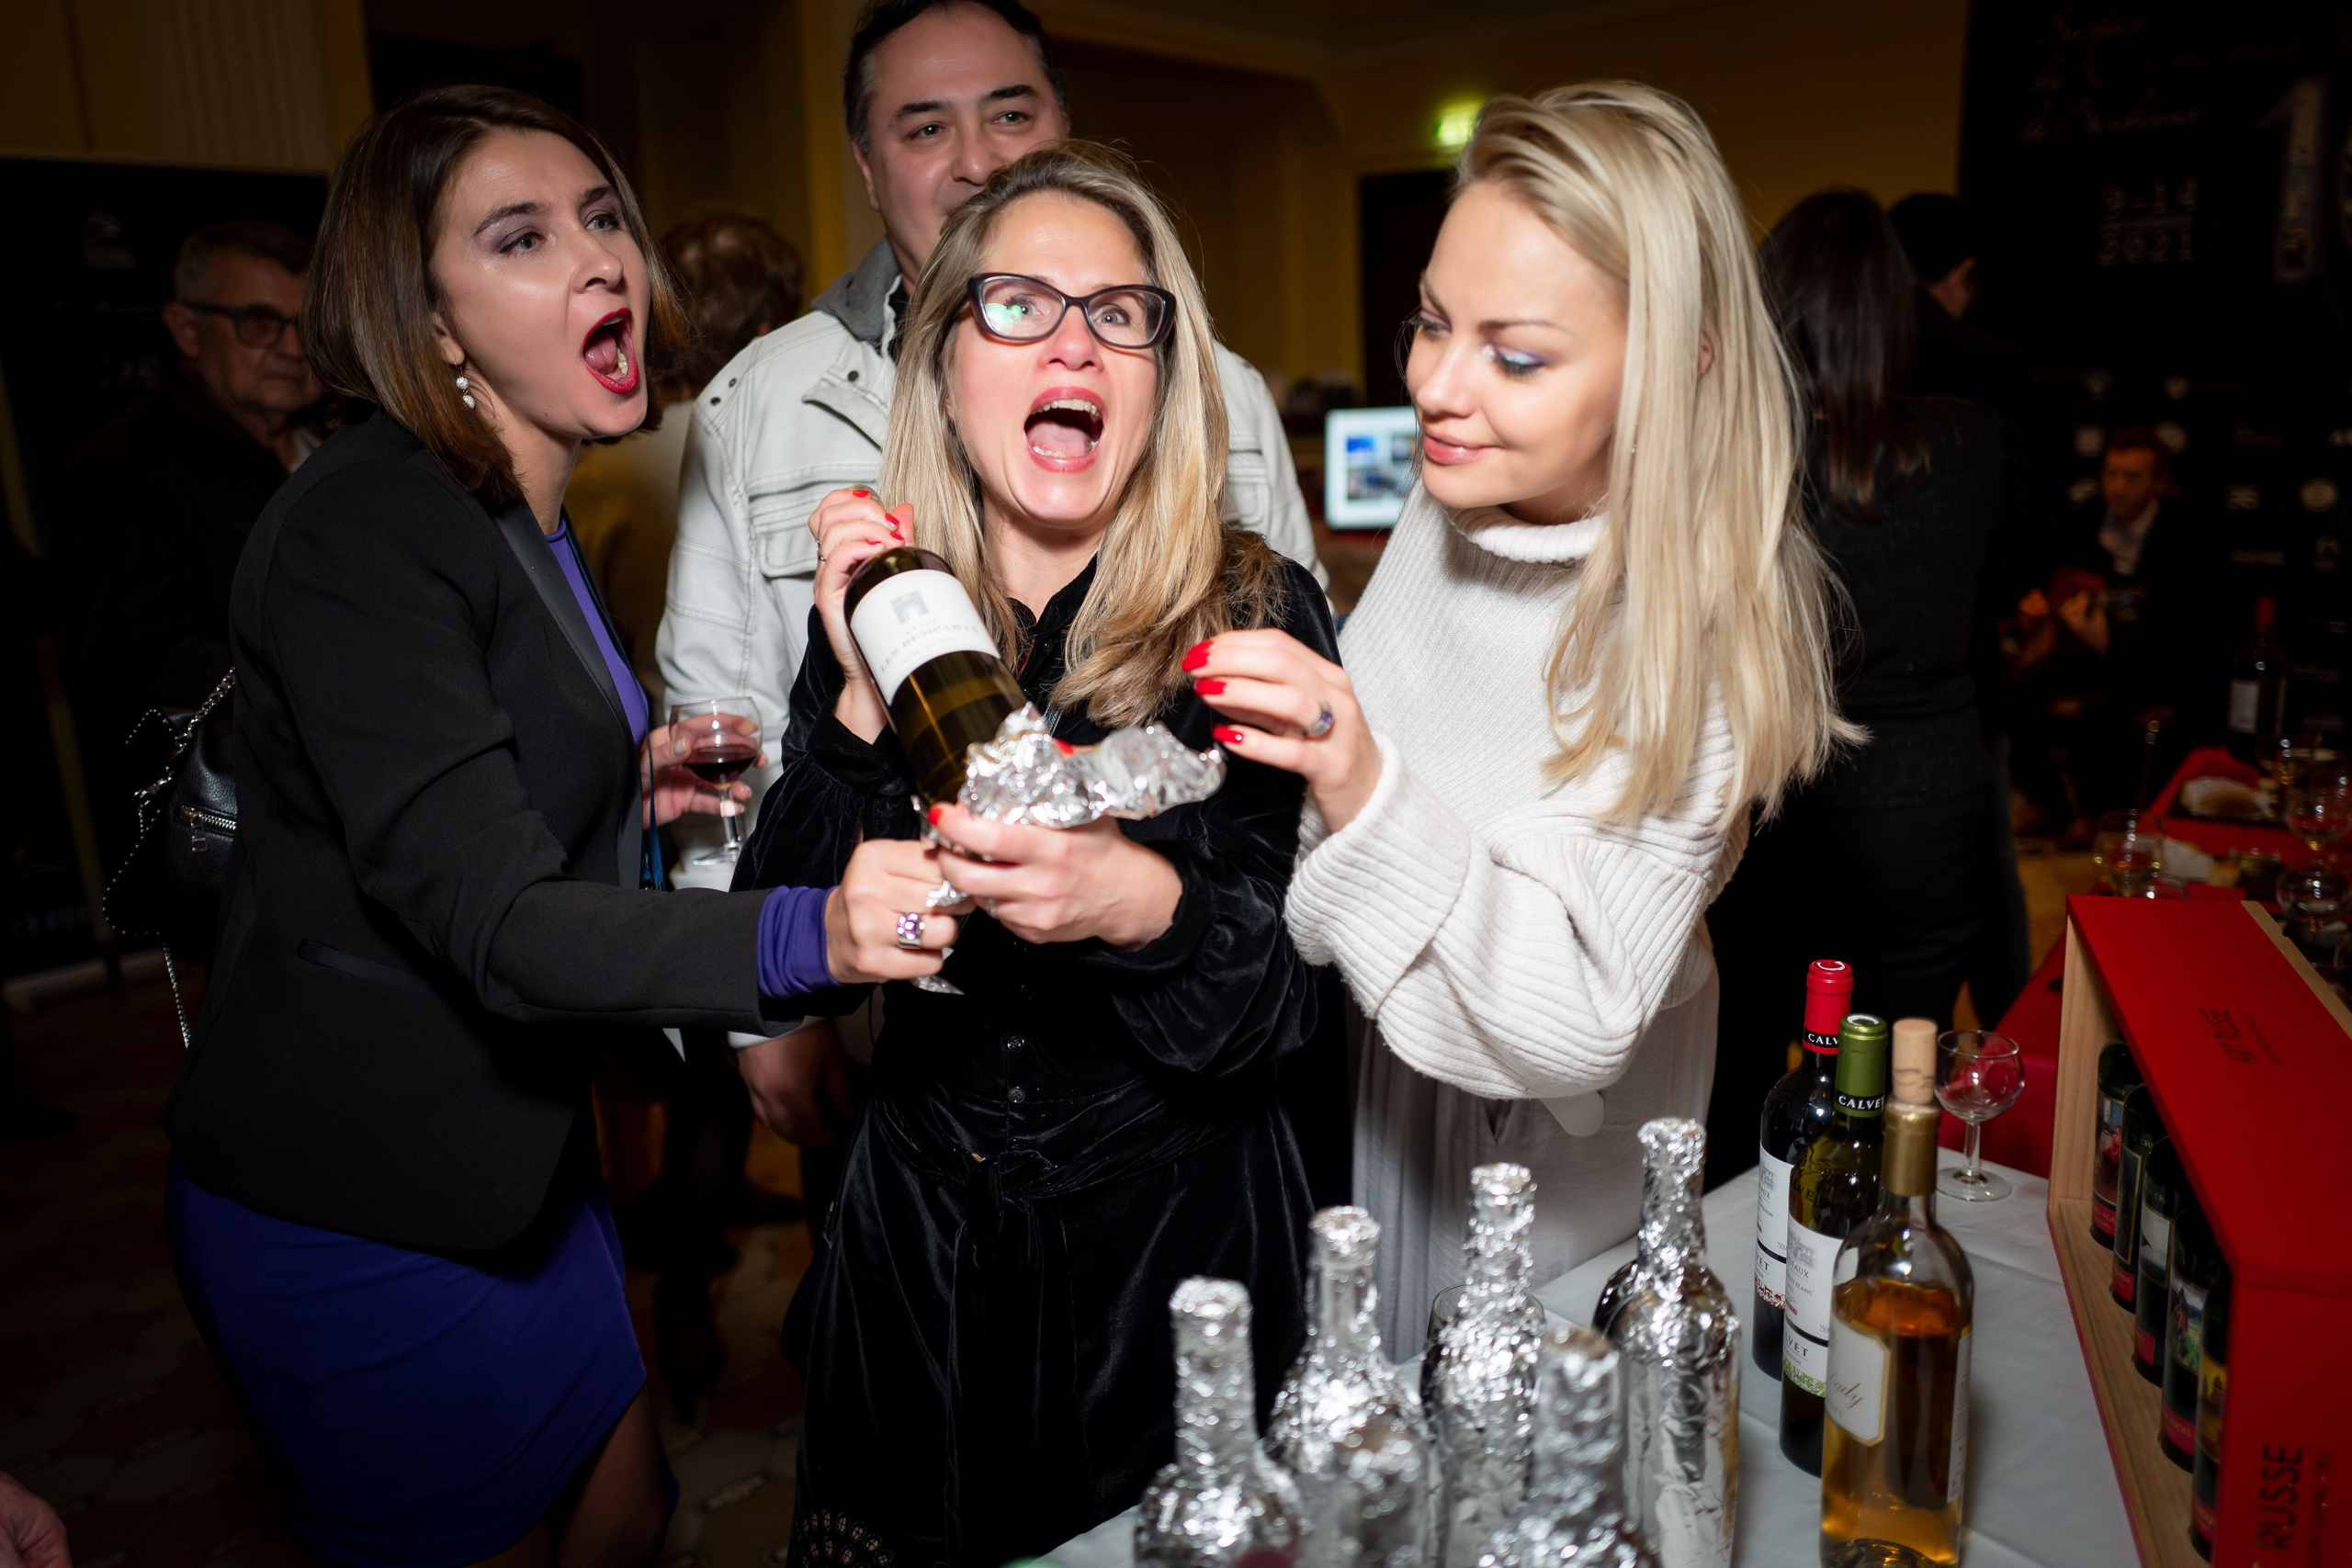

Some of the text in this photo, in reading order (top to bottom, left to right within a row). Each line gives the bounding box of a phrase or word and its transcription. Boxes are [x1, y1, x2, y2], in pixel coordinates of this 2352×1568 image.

[2096, 230, 2196, 267] 2021
[2199, 1008, 2245, 1040] RUSSE
[1807, 1032, 1839, 1045] CALV
[1838, 1094, 1886, 1111] CALVET
[1795, 1281, 1814, 1298] BLANC
[1785, 1331, 1809, 1358] LVET
[2256, 1444, 2302, 1551] RUSSE
